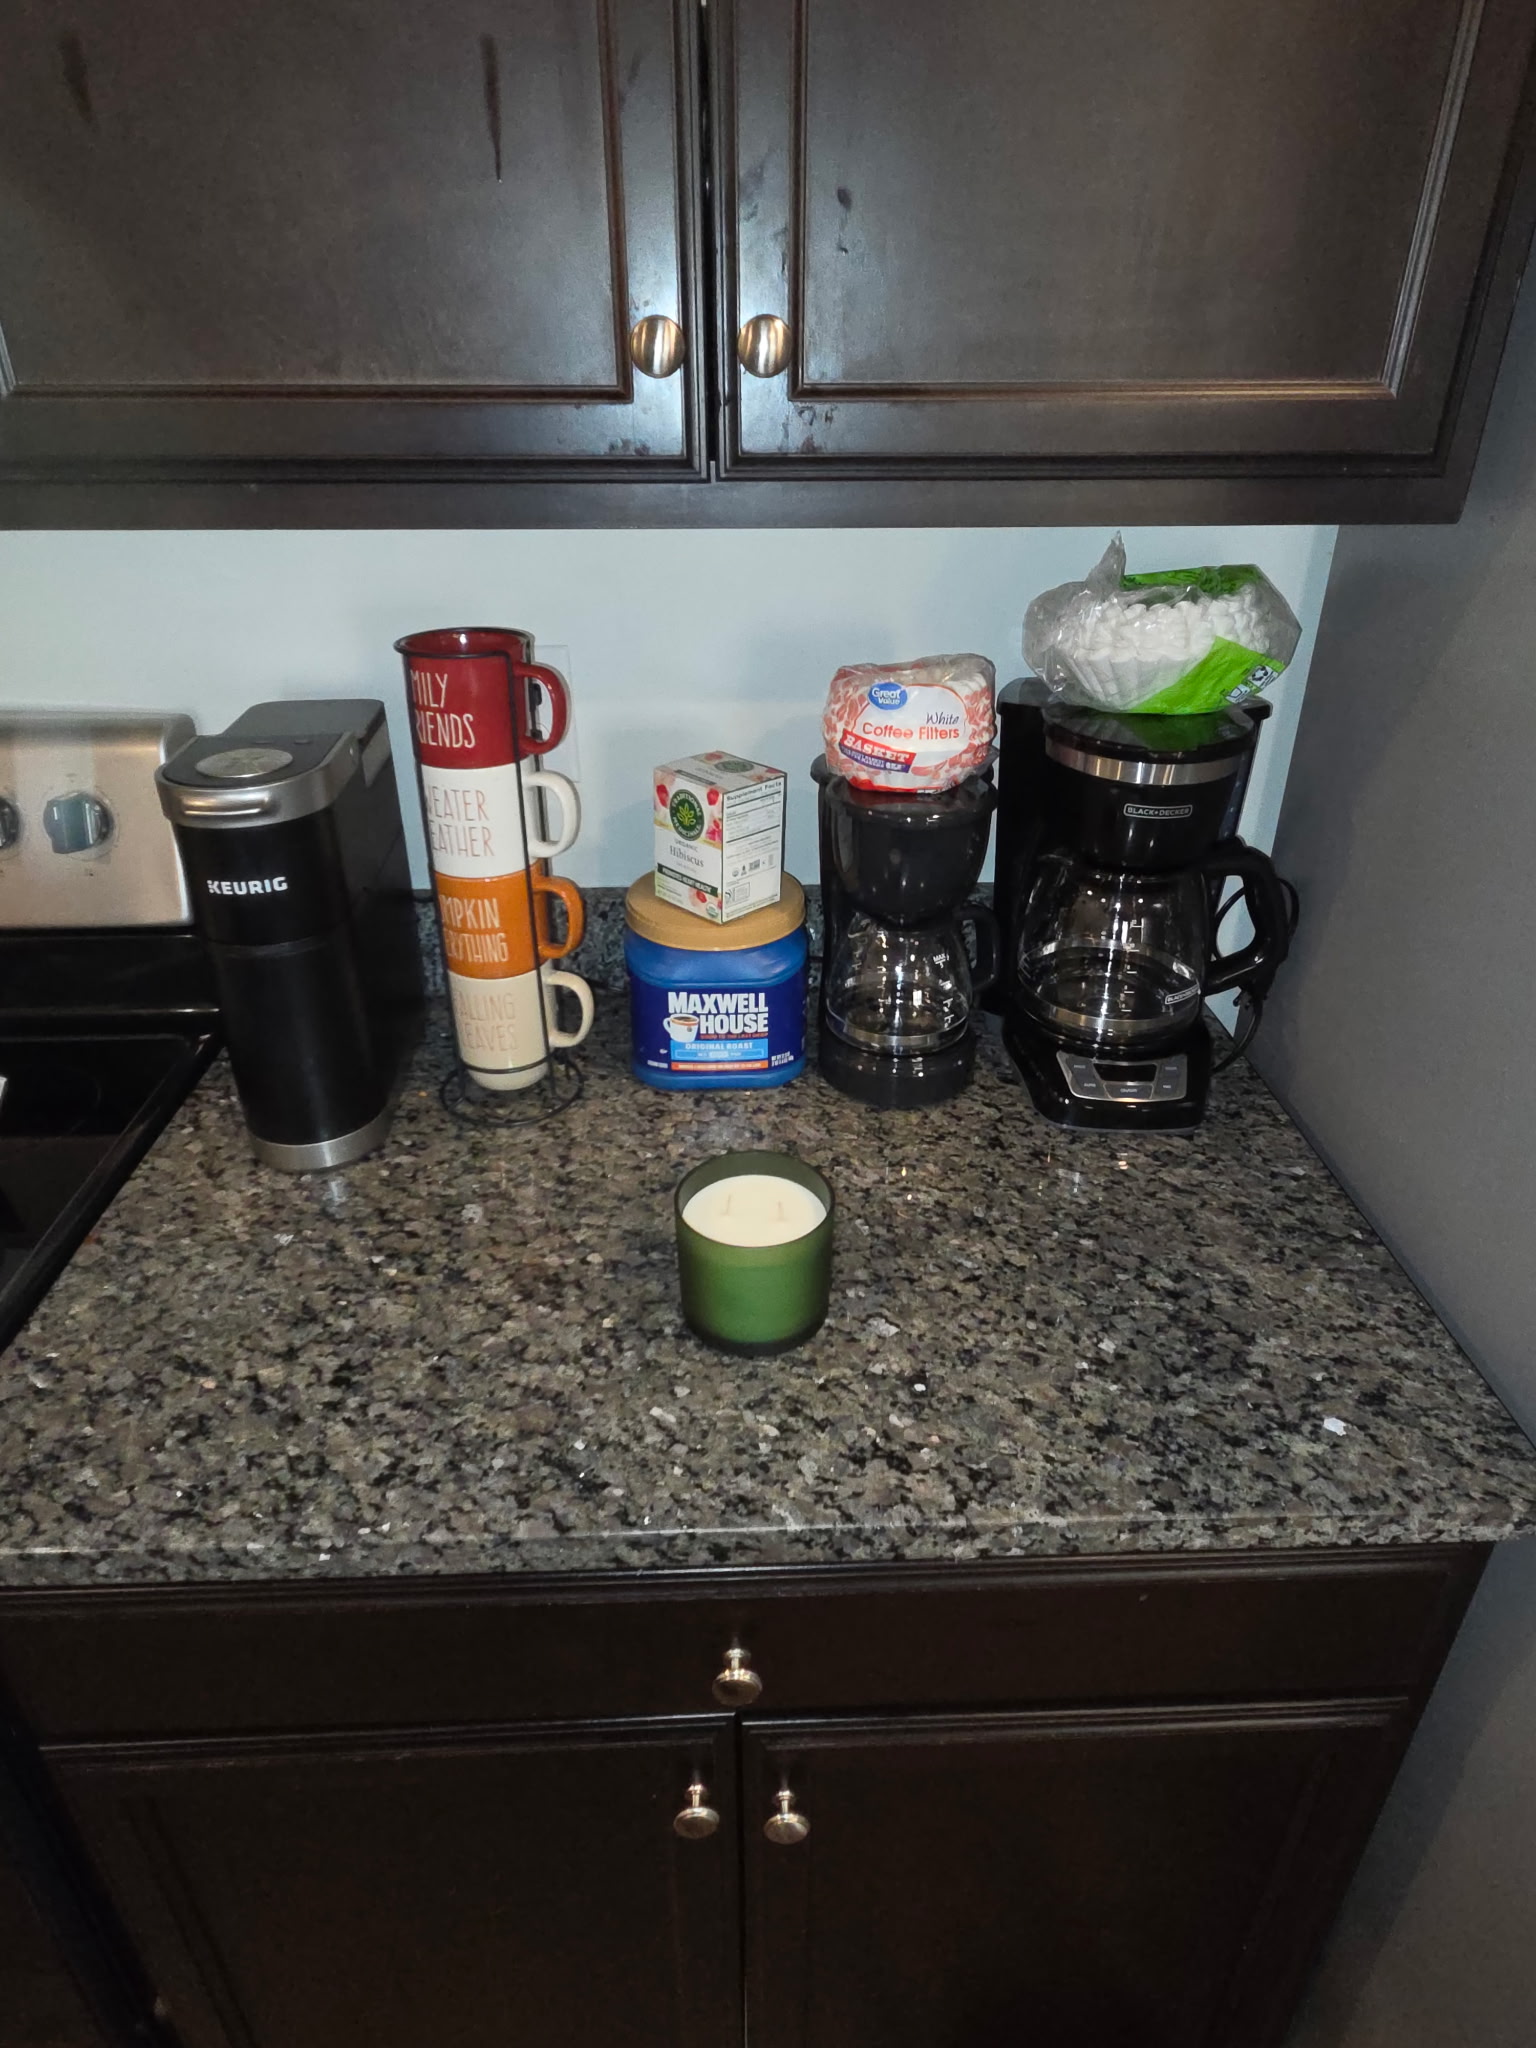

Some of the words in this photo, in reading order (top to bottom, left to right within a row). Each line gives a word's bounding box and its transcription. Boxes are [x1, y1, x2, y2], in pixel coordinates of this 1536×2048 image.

[872, 687, 901, 699] Great
[878, 696, 901, 705] Value
[926, 711, 960, 725] White
[862, 722, 913, 739] Coffee
[918, 726, 960, 740] Filters
[843, 734, 910, 763] BASKET
[669, 845, 704, 868] Hibiscus
[207, 876, 289, 896] KEURIG
[667, 992, 769, 1014] MAXWELL
[700, 1012, 769, 1035] HOUSE
[685, 1042, 724, 1050] ORIGINAL
